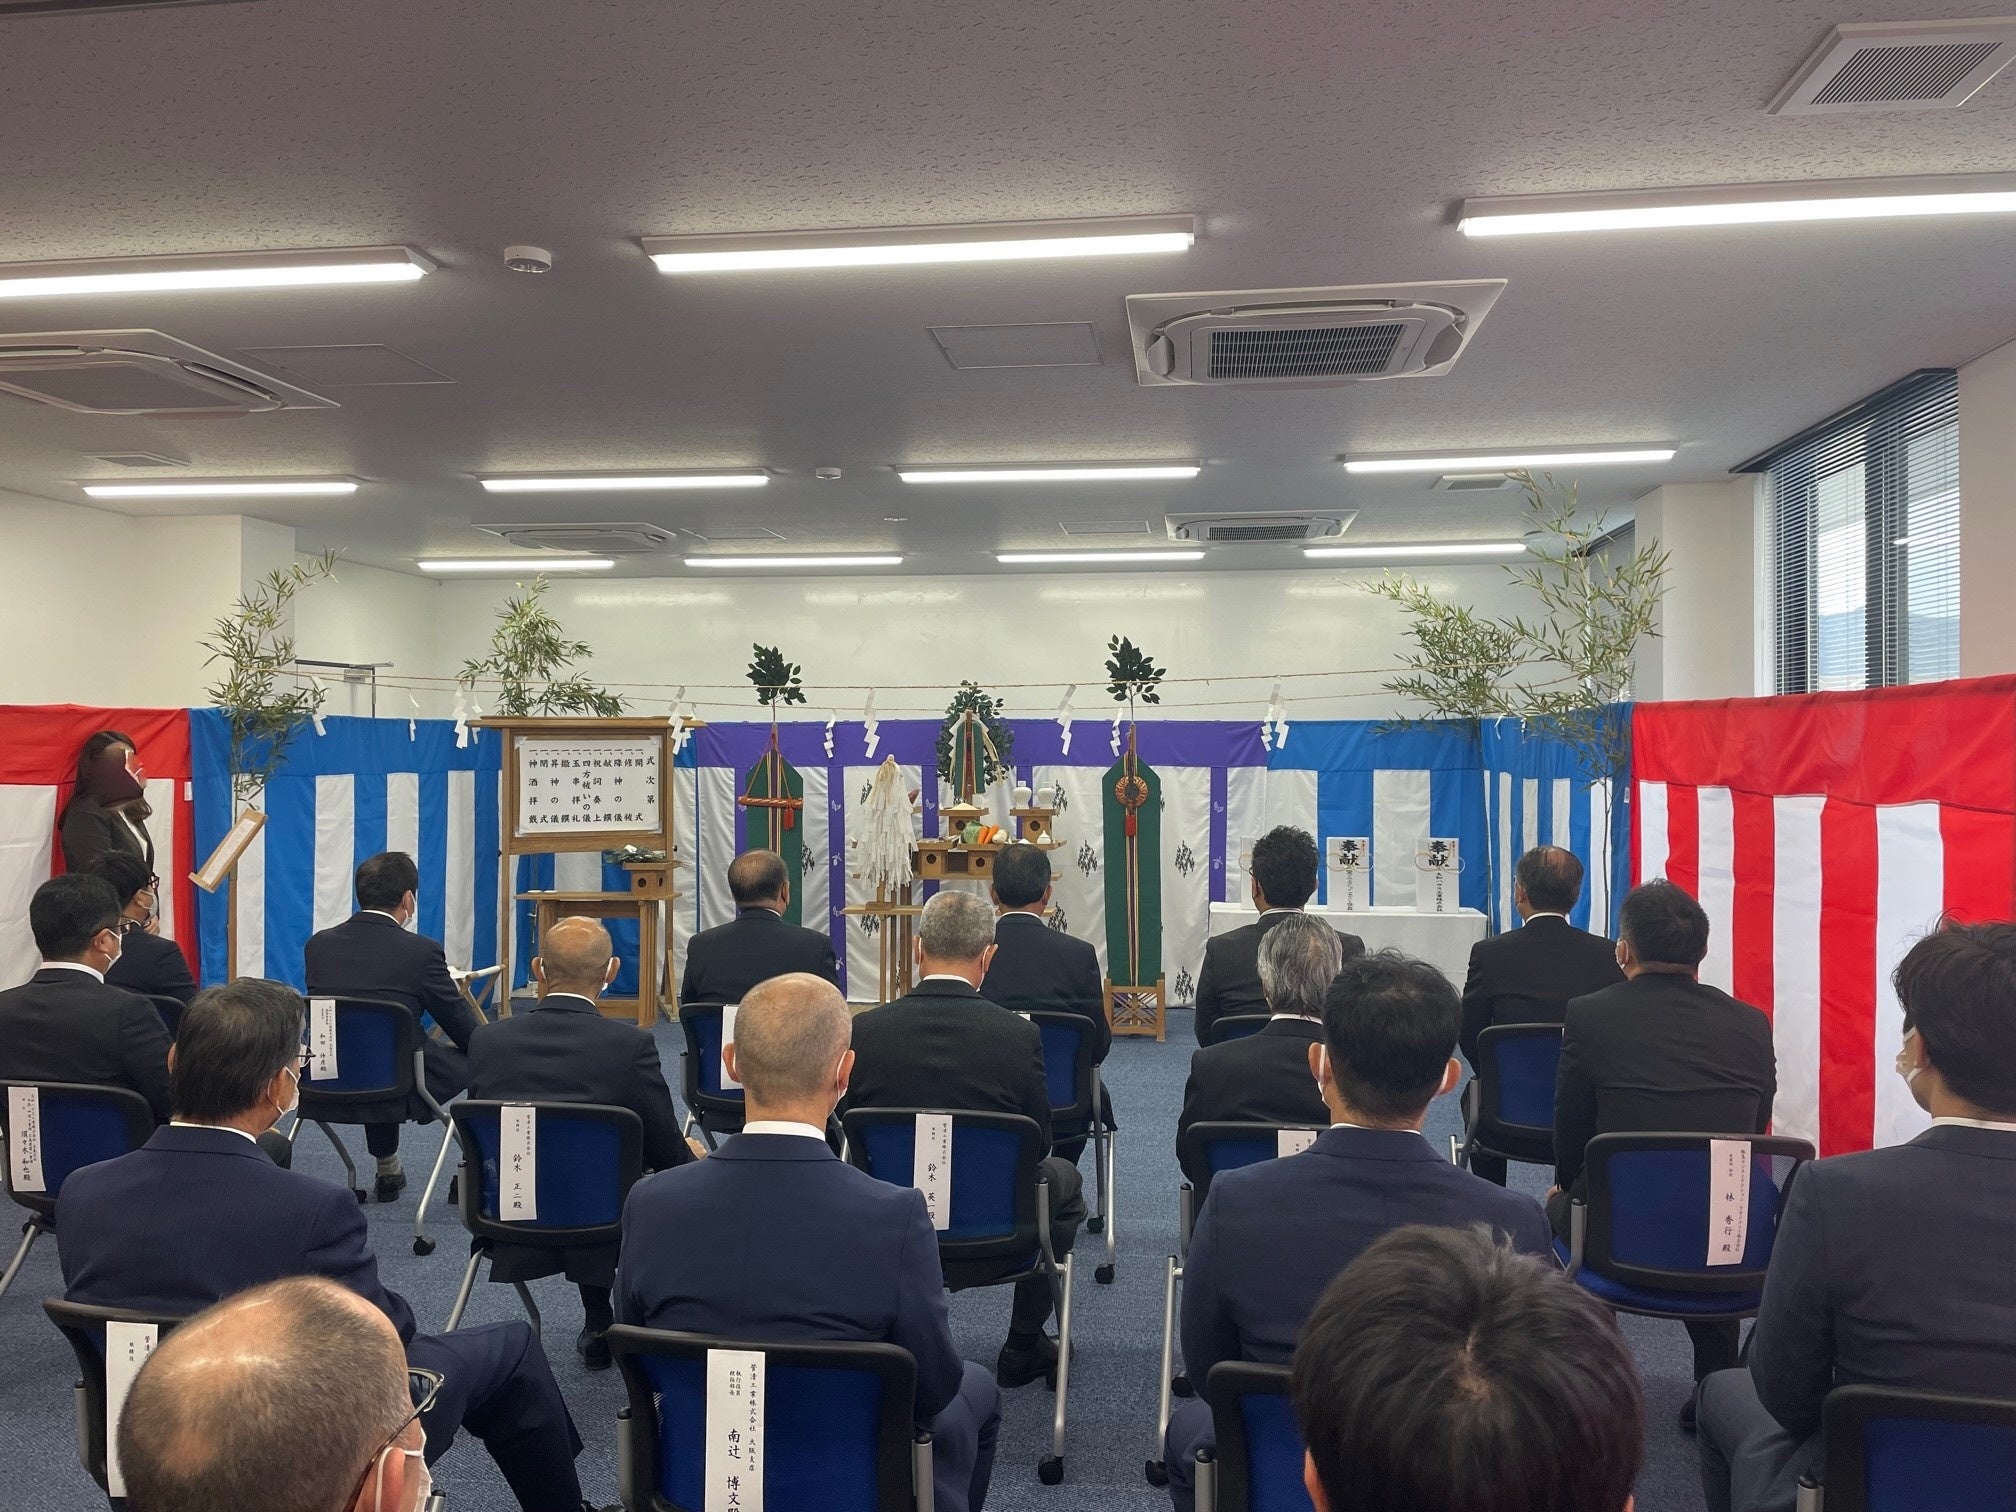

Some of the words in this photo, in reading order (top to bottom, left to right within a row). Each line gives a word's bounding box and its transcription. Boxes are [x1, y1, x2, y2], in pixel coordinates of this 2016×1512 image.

[646, 756, 656, 805] 式次第
[1339, 839, 1360, 866] 奉献
[1428, 840, 1450, 867] 奉献
[513, 1154, 522, 1172] 鈴木
[927, 1163, 937, 1182] 鈴木
[1725, 1192, 1735, 1202] 林
[728, 1429, 742, 1460] 南辻
